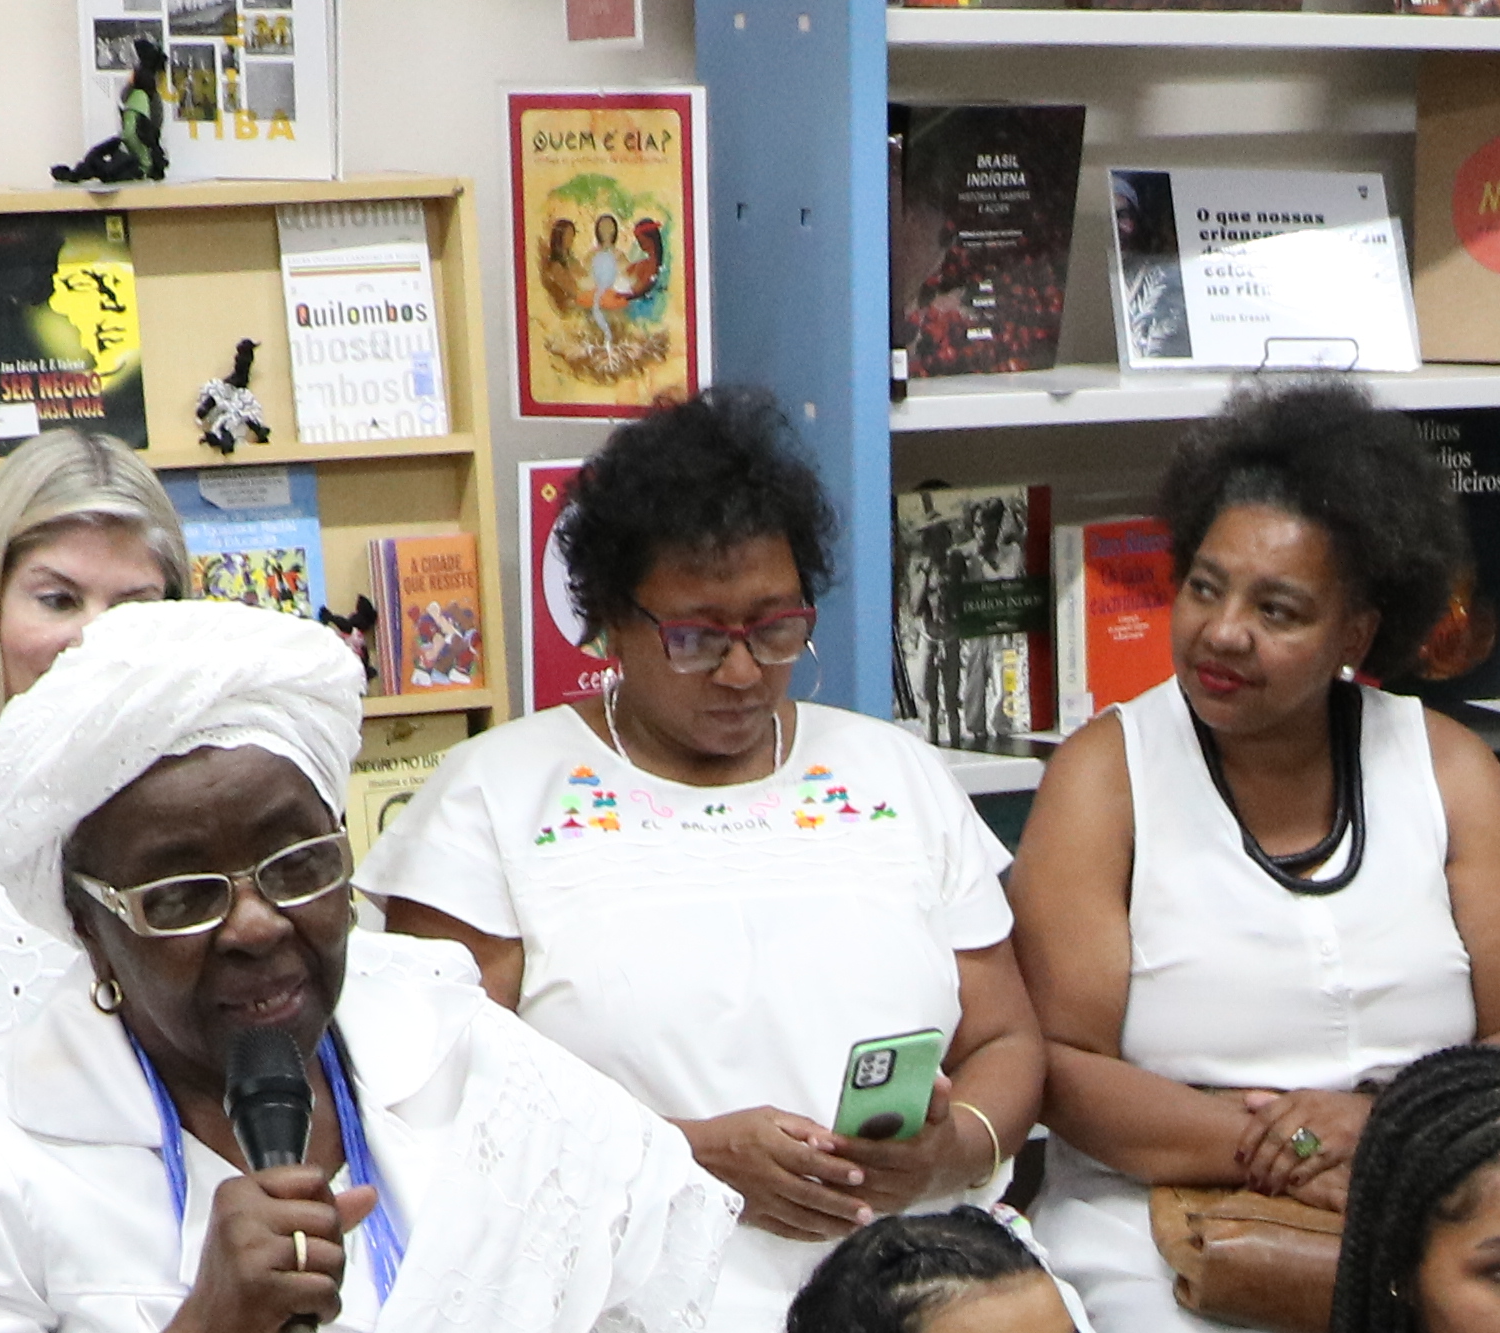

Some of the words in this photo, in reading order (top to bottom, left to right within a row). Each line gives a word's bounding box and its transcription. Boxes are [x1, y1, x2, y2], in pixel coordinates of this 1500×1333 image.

[1197, 207, 1210, 223] O
[1216, 210, 1251, 226] que
[1257, 211, 1325, 225] nossas
[296, 299, 428, 328] Quilombos
[1, 374, 35, 400] SER
[38, 371, 102, 399] NEGRO
